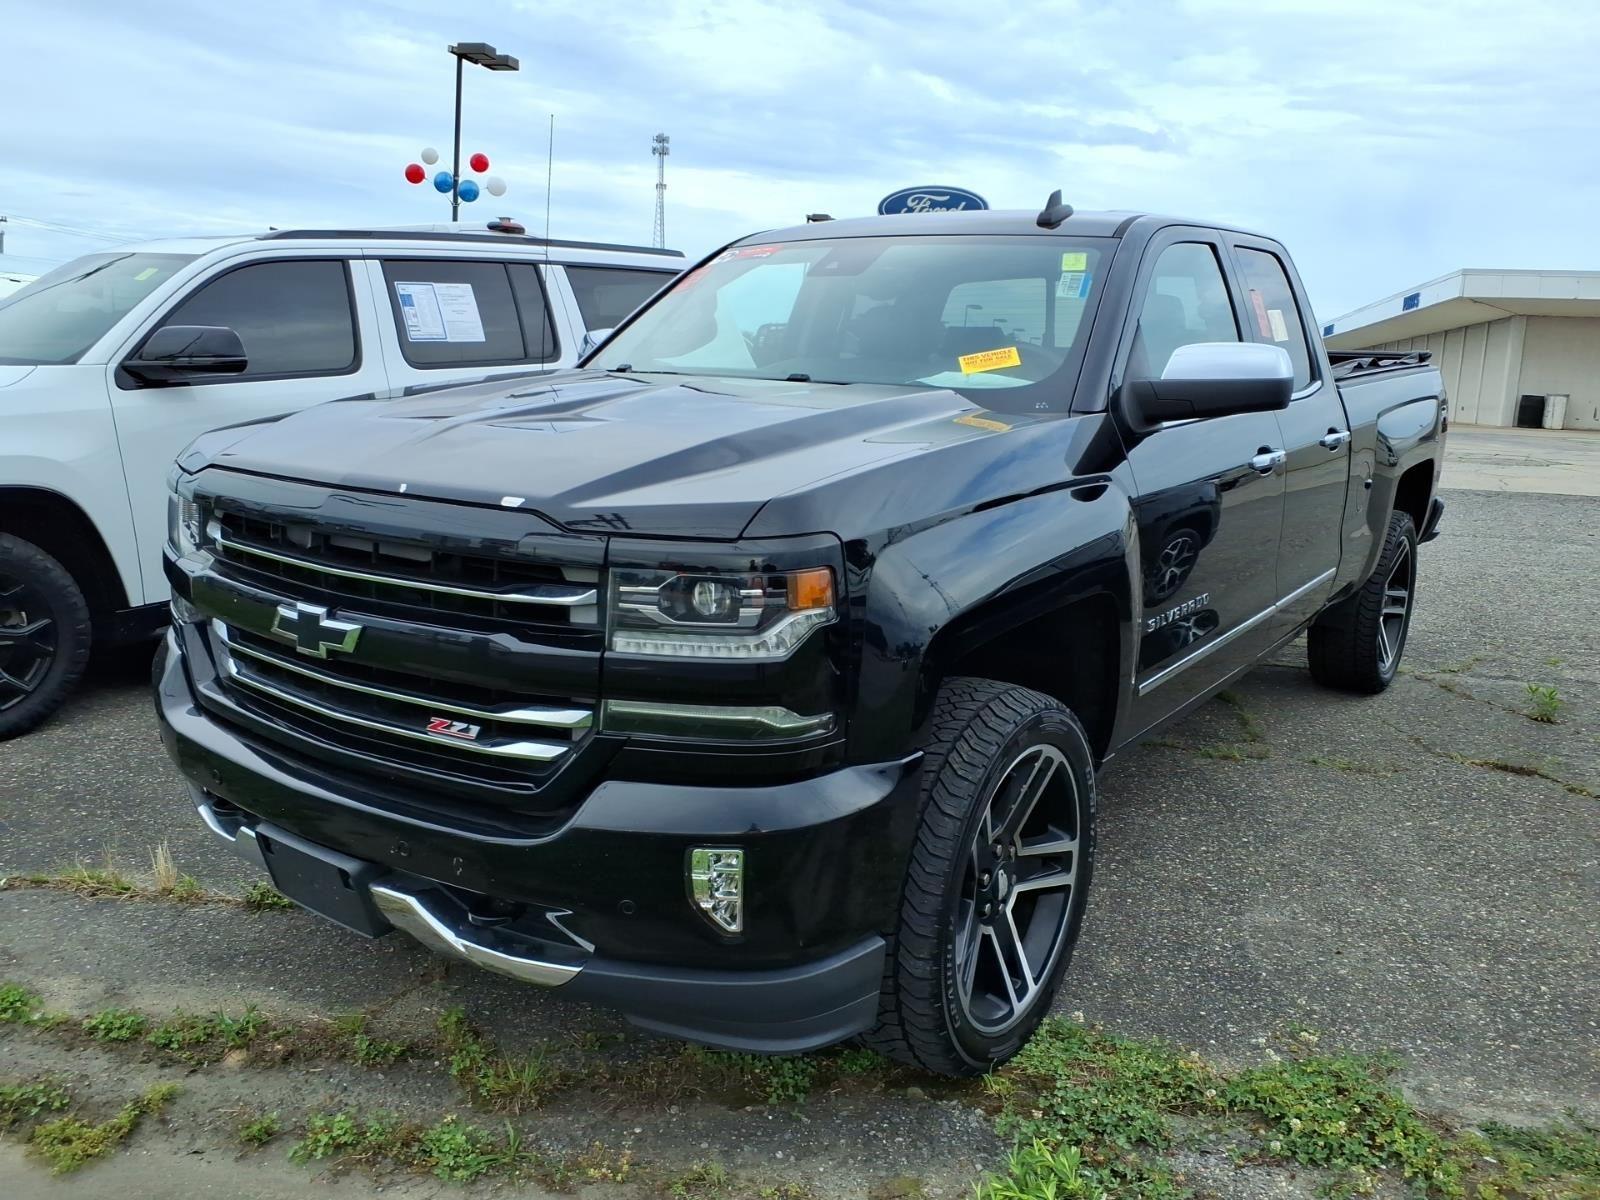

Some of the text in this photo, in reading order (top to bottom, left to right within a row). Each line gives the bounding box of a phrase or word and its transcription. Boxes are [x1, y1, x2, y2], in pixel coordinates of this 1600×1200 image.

[901, 193, 967, 214] Ford
[1147, 593, 1209, 632] SILVERADO
[426, 717, 480, 740] Z71
